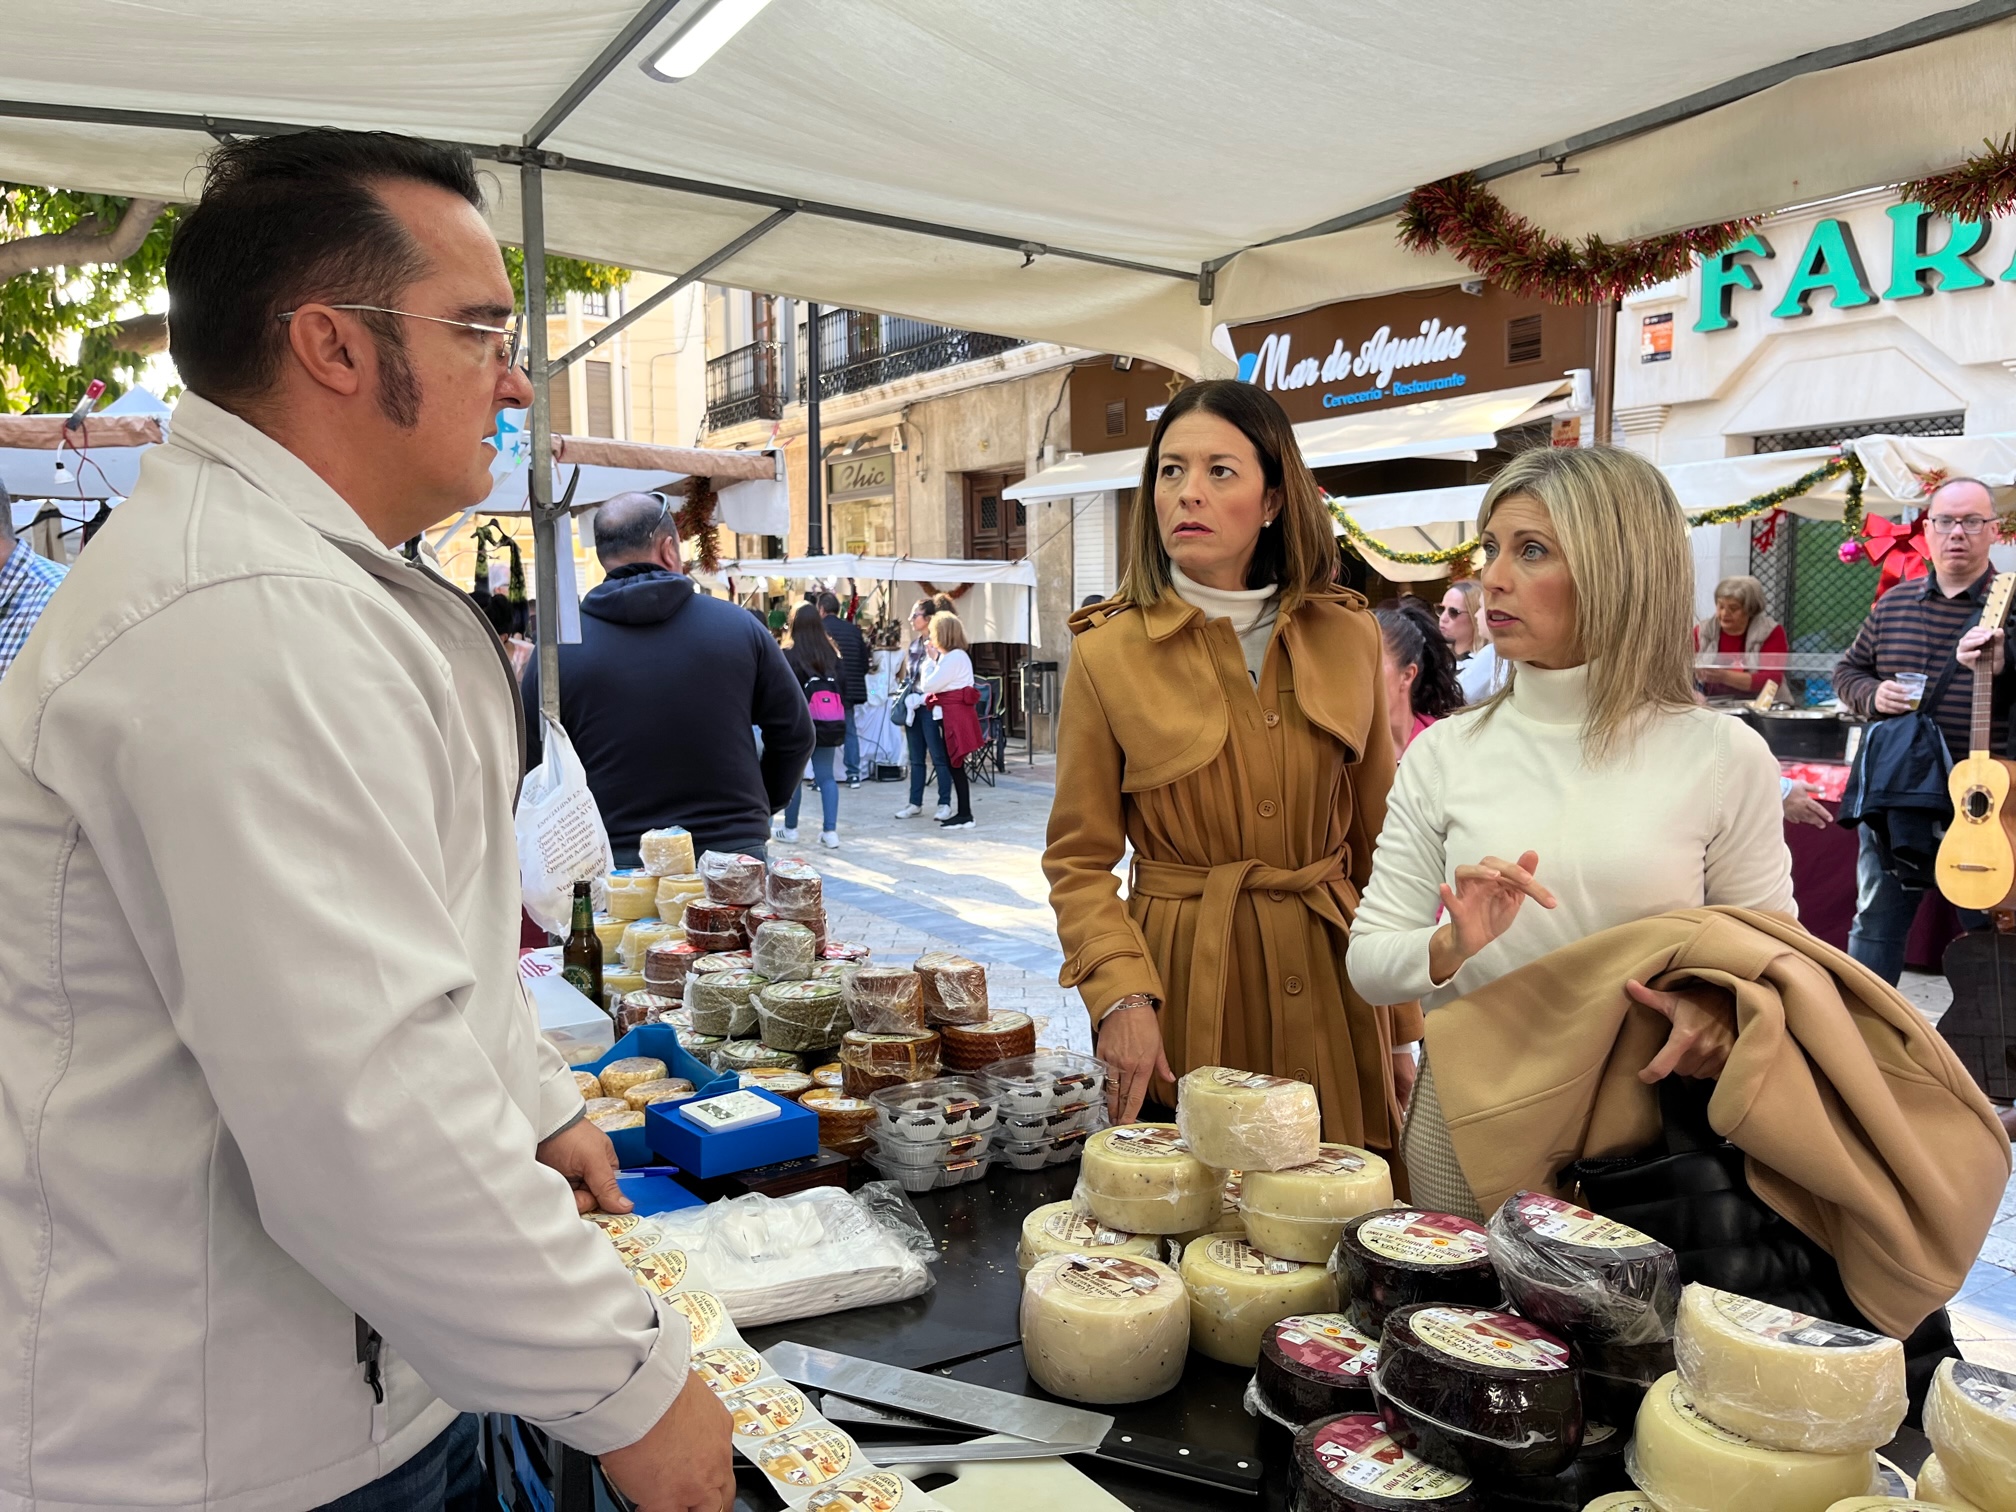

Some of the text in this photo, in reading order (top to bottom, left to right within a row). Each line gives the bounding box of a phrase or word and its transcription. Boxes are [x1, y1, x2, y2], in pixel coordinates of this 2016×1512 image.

[1692, 200, 2016, 332] FAR
[1250, 333, 1320, 392] Mar
[1321, 338, 1352, 384] de
[1392, 372, 1467, 397] Restaurante
[840, 462, 886, 490] Chic
[1395, 1237, 1424, 1247] MURCIA
[1581, 1229, 1599, 1241] VINO
[1436, 1248, 1460, 1259] QUESO
[691, 1293, 709, 1315] DEL FRAILE
[703, 1299, 718, 1318] GRANJA
[1420, 1316, 1439, 1325] VINO
[1450, 1329, 1483, 1344] MURCIA
[1430, 1332, 1481, 1358] LA GRANJA
[1449, 1333, 1501, 1361] DEL FRAILE
[1493, 1348, 1522, 1364] QUESO
[869, 1476, 884, 1489] FRAILE
[877, 1473, 896, 1488] GRANJA
[1383, 1478, 1402, 1490] VINO
